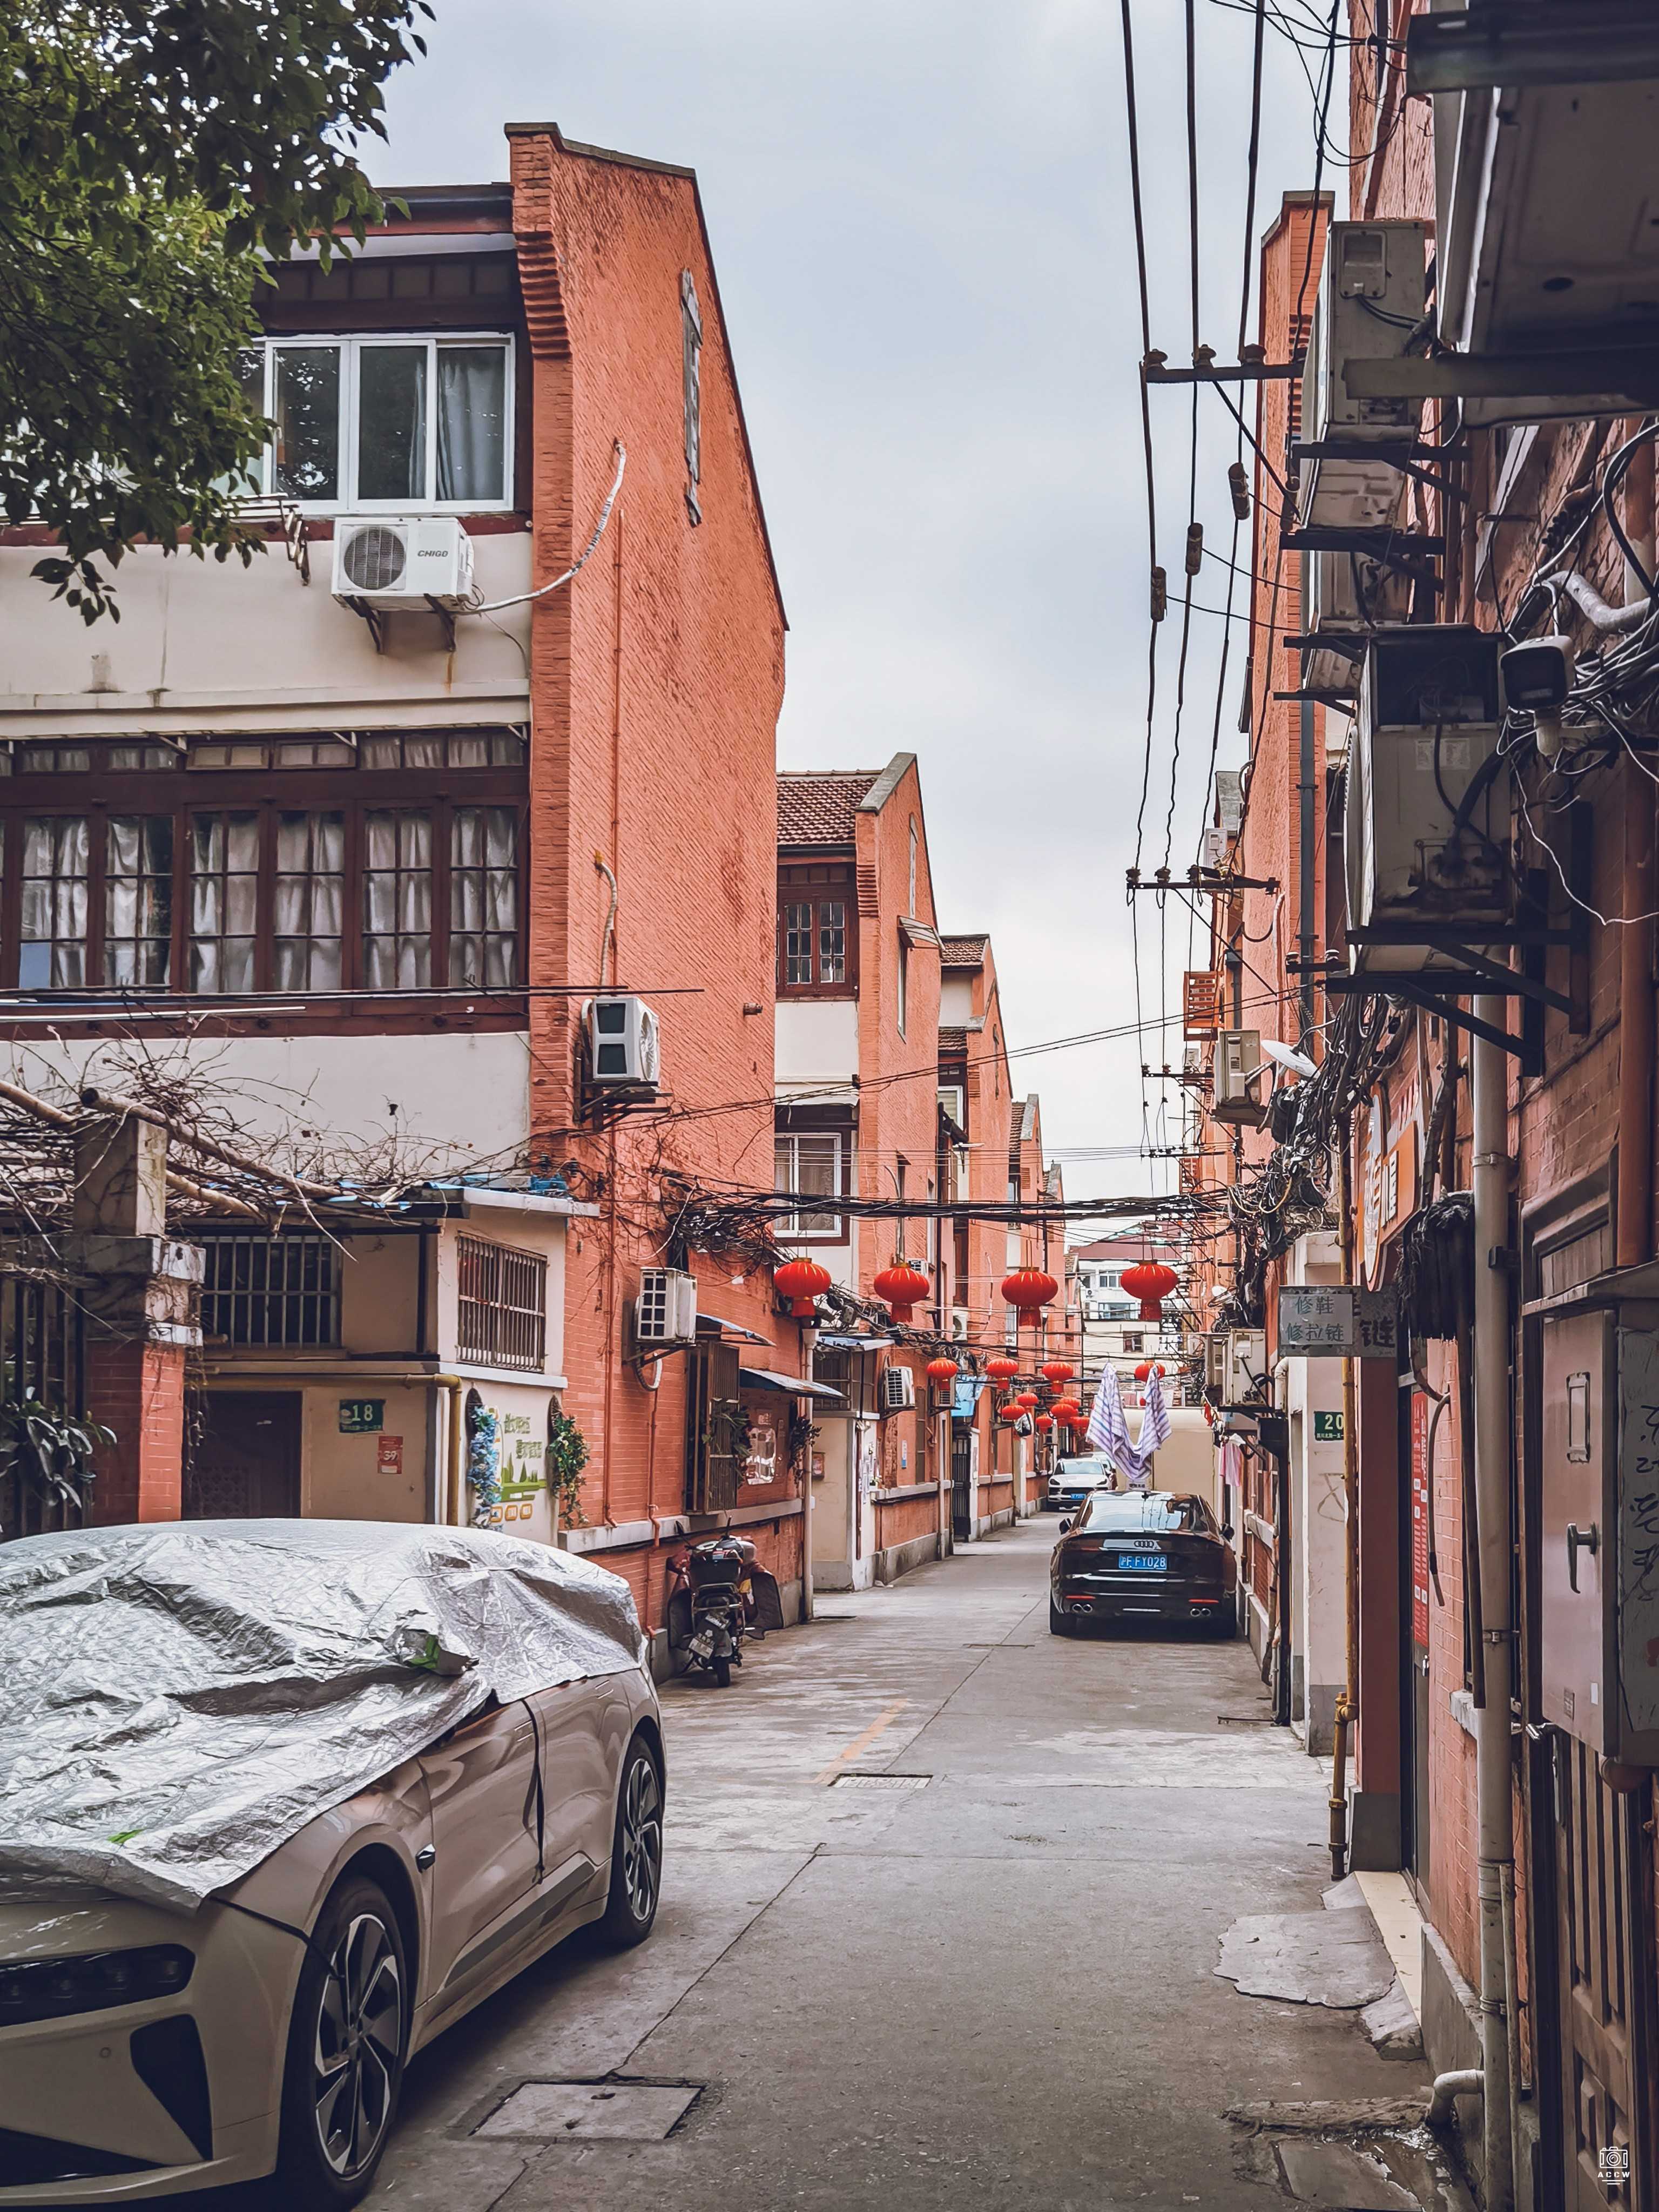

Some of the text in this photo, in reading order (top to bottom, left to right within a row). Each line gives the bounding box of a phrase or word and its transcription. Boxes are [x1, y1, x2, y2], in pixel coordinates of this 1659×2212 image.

[1294, 1296, 1335, 1315] 修鞋
[1285, 1323, 1344, 1342] 修拉链
[352, 1404, 373, 1421] 18
